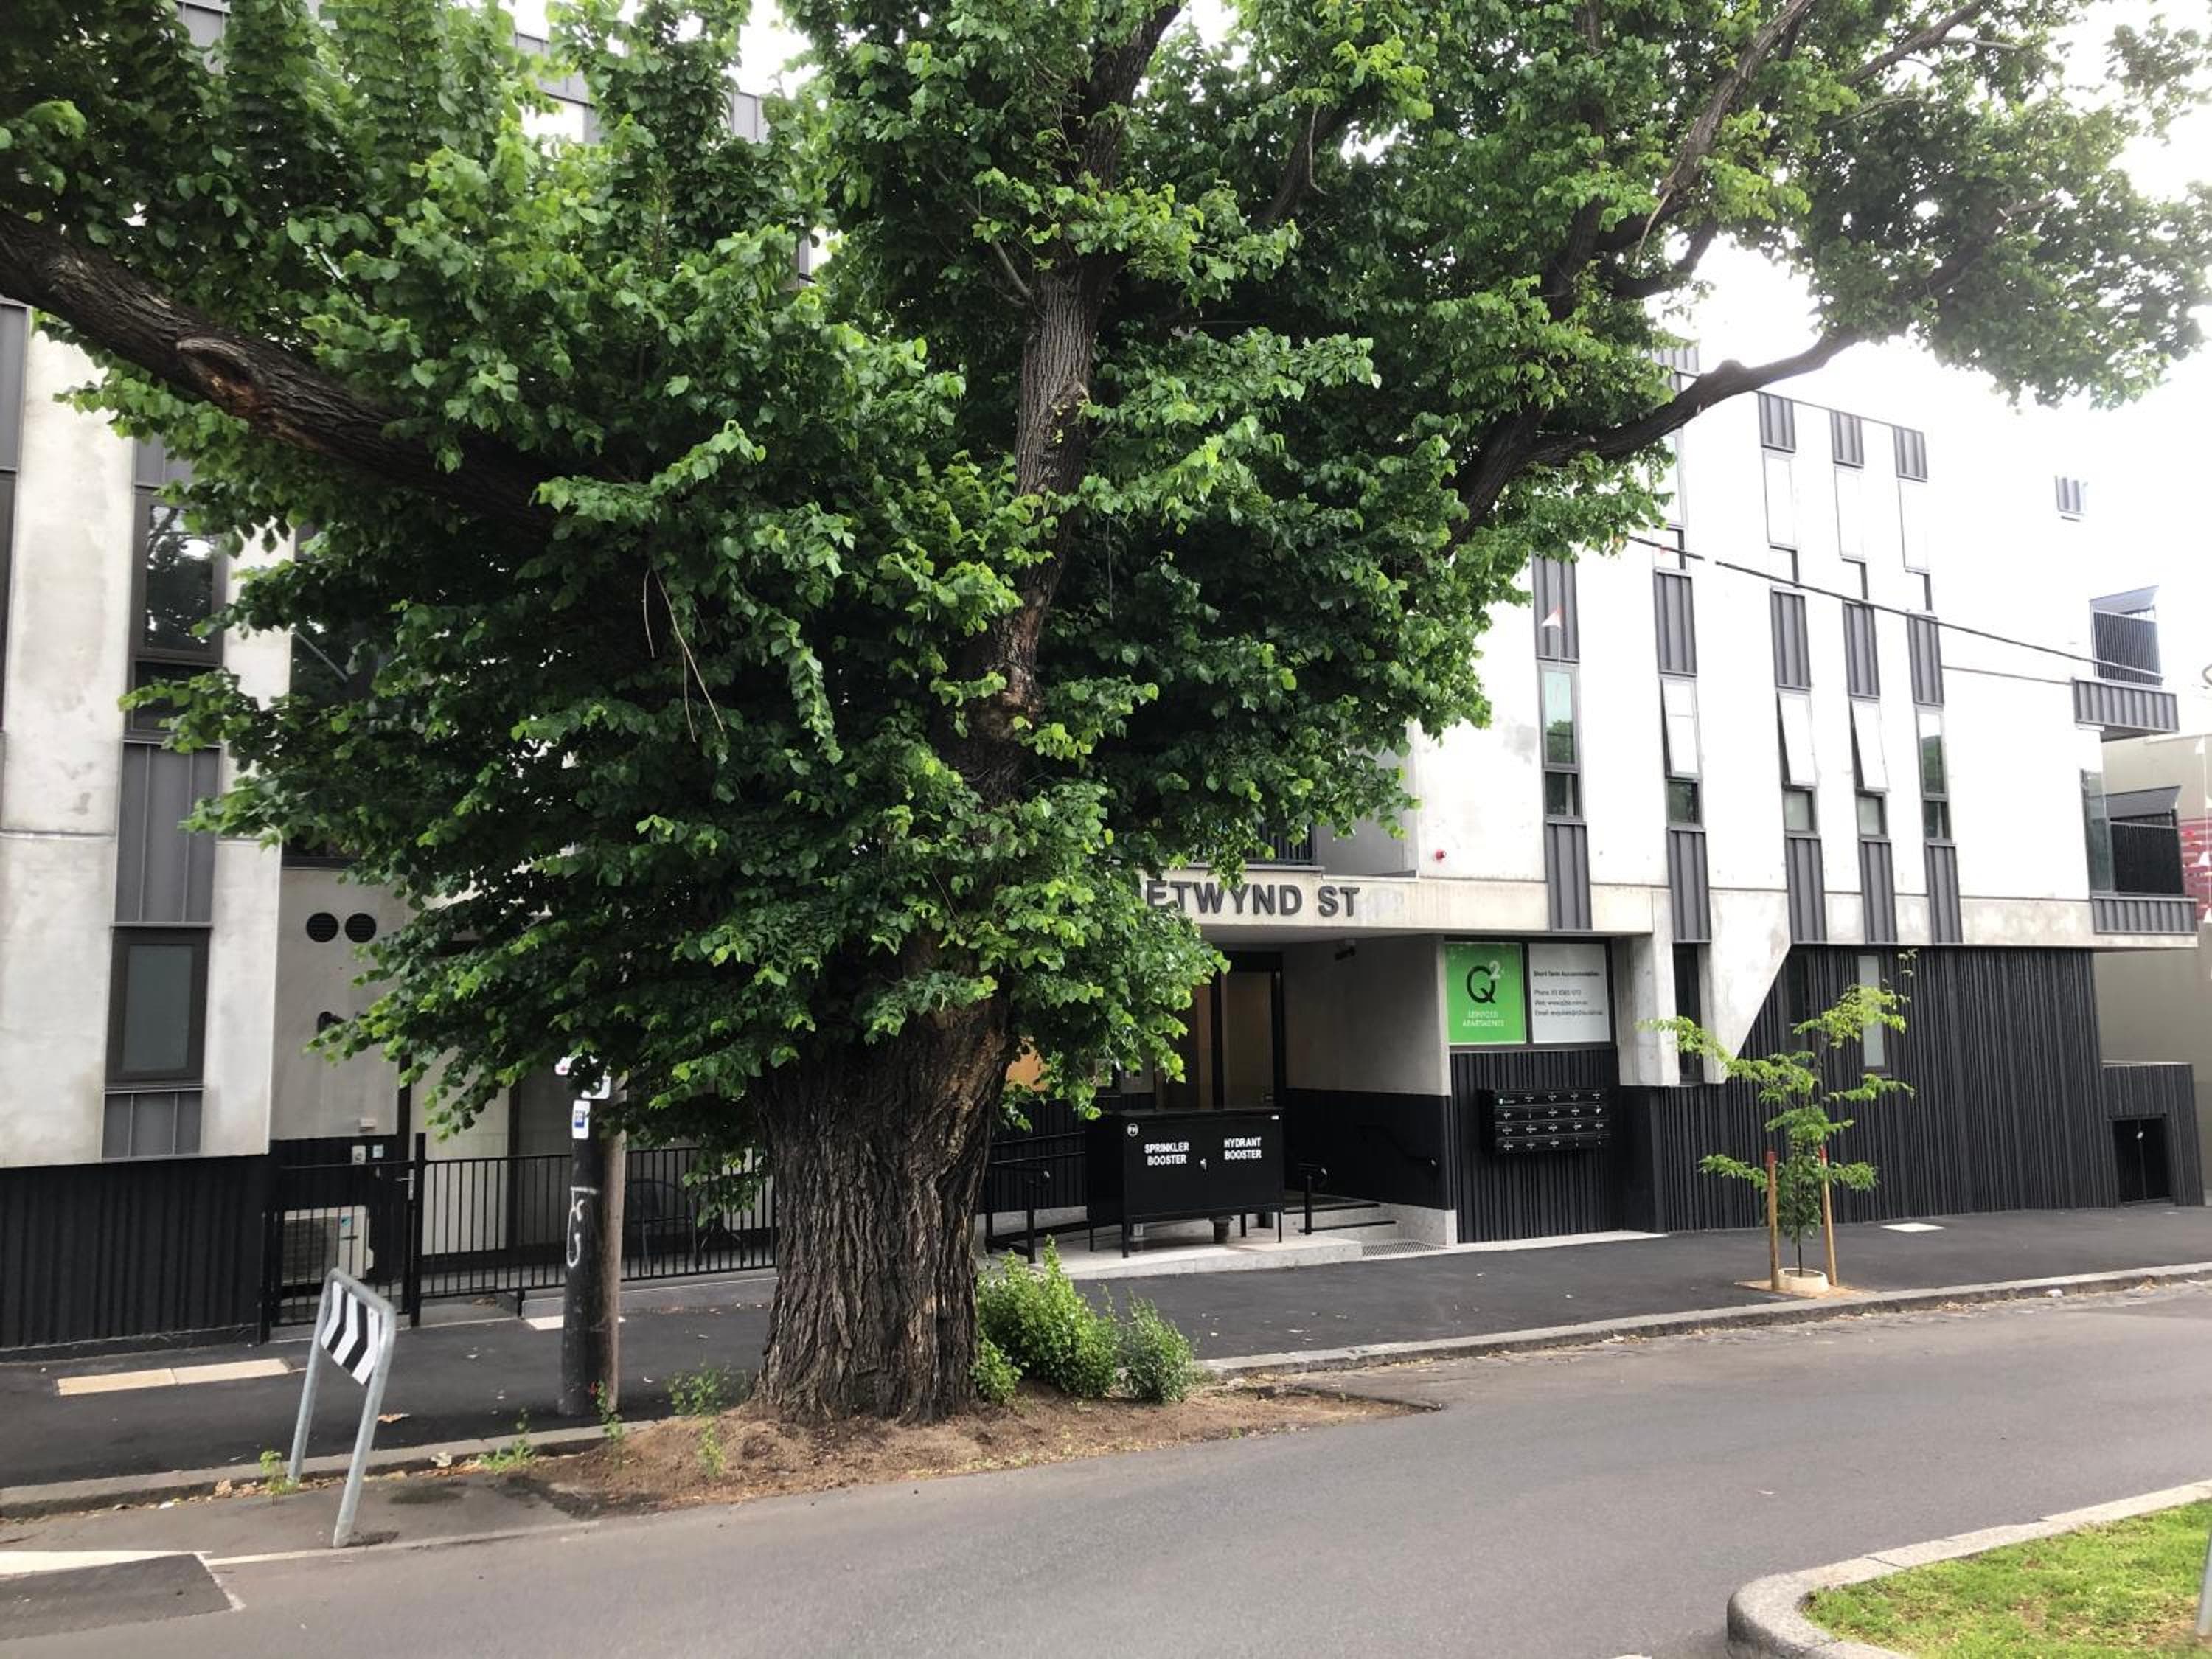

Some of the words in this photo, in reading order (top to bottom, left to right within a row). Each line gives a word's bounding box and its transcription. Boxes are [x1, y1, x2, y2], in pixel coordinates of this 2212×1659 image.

[1318, 886, 1360, 917] ST
[1462, 1019, 1505, 1027] APARTMENTS
[1144, 1142, 1189, 1154] SPRINKLER
[1224, 1136, 1262, 1148] HYDRANT
[1147, 1154, 1187, 1166] BOOSTER
[1224, 1149, 1262, 1161] BOOSTER
